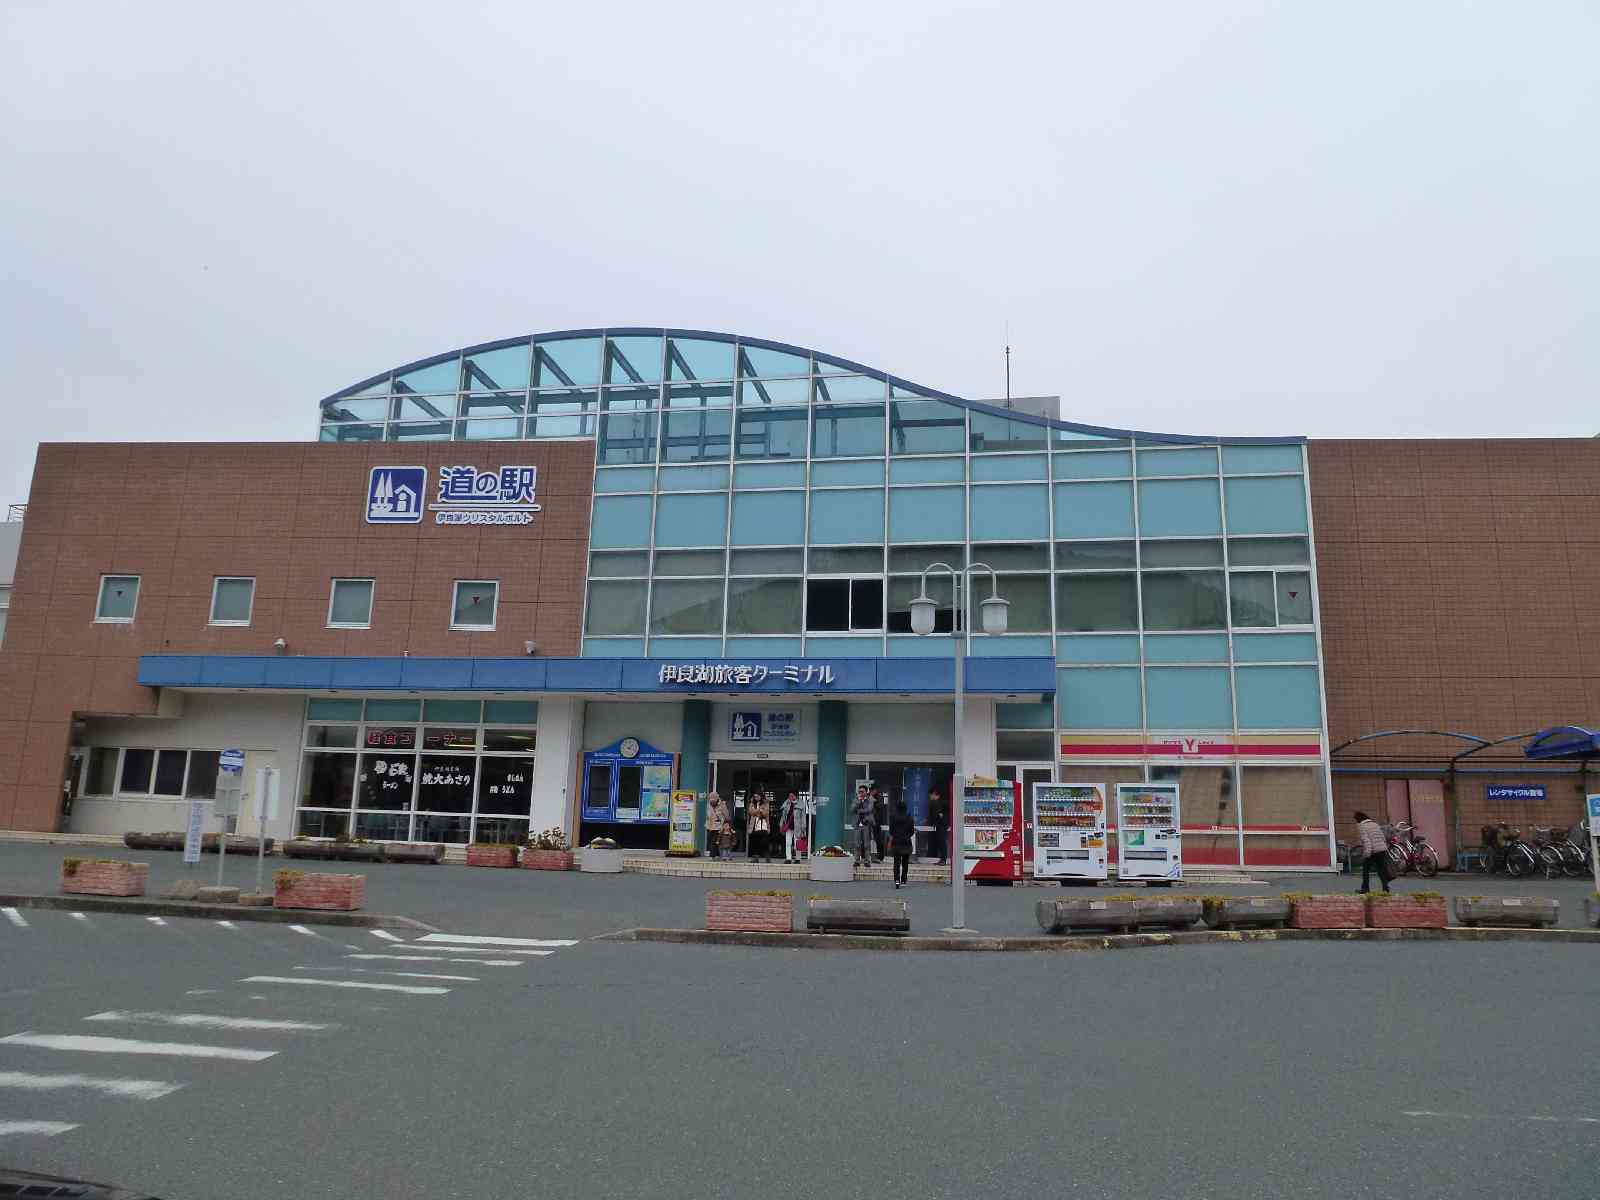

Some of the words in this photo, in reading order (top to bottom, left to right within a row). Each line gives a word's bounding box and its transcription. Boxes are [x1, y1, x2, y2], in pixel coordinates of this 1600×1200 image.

[438, 466, 536, 504] 道の駅
[658, 664, 835, 684] 伊良湖旅客ターミナル
